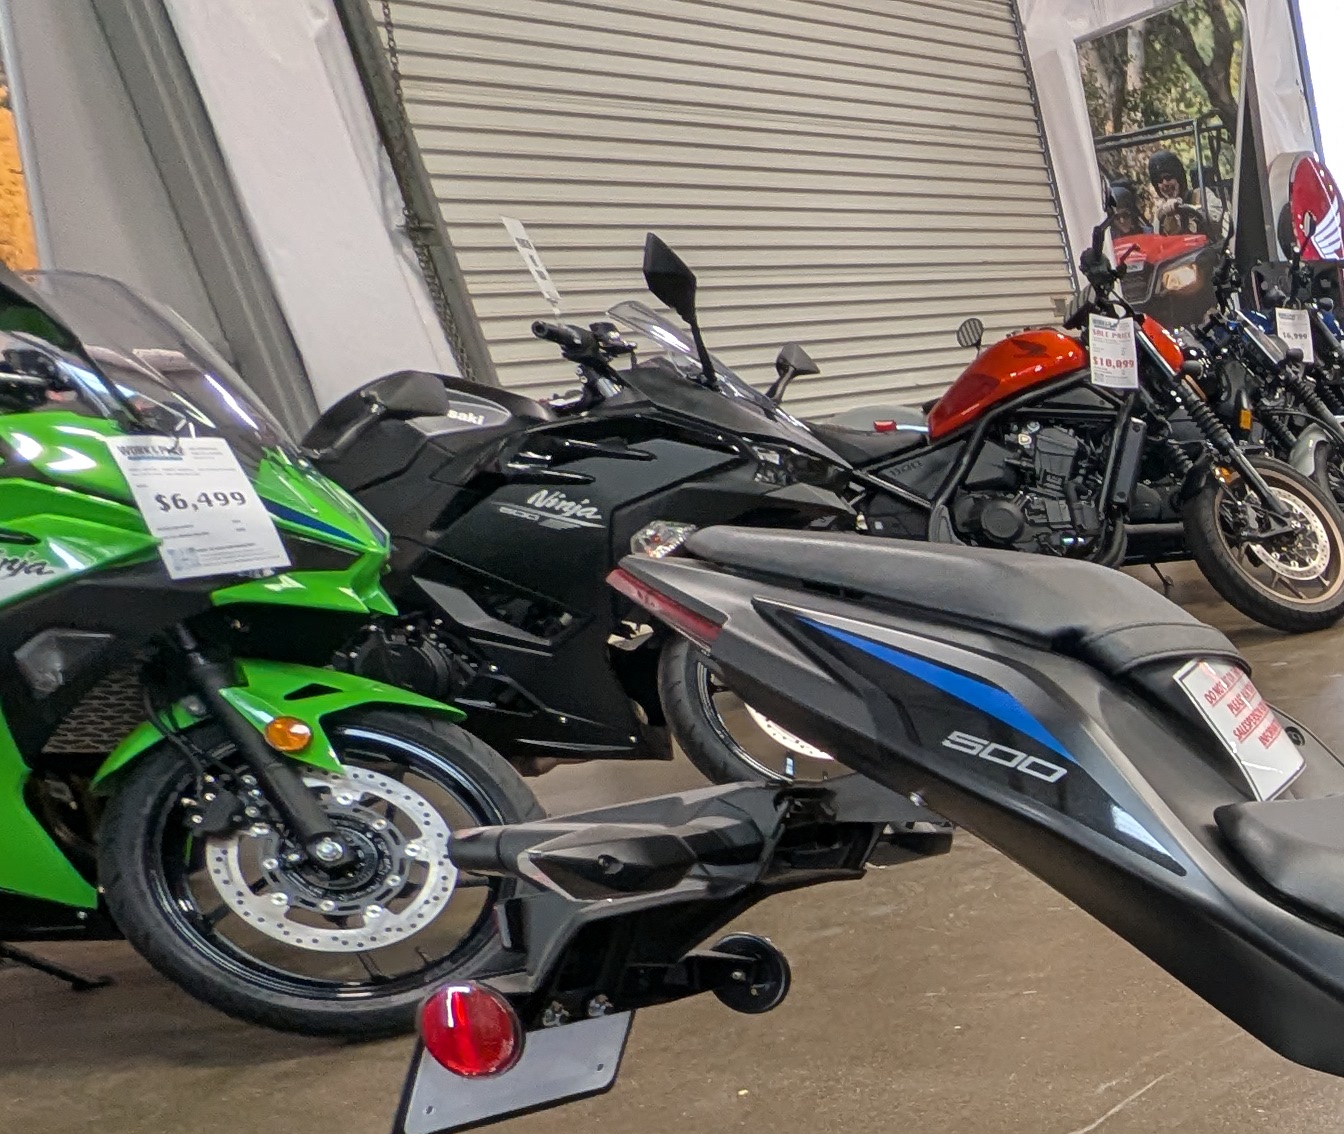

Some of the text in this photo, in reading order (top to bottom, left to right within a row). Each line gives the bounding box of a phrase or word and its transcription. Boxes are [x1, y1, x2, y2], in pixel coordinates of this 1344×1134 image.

[447, 409, 485, 426] saki
[155, 491, 247, 512] $6,499
[527, 489, 602, 520] Ninja
[942, 731, 1068, 783] 500
